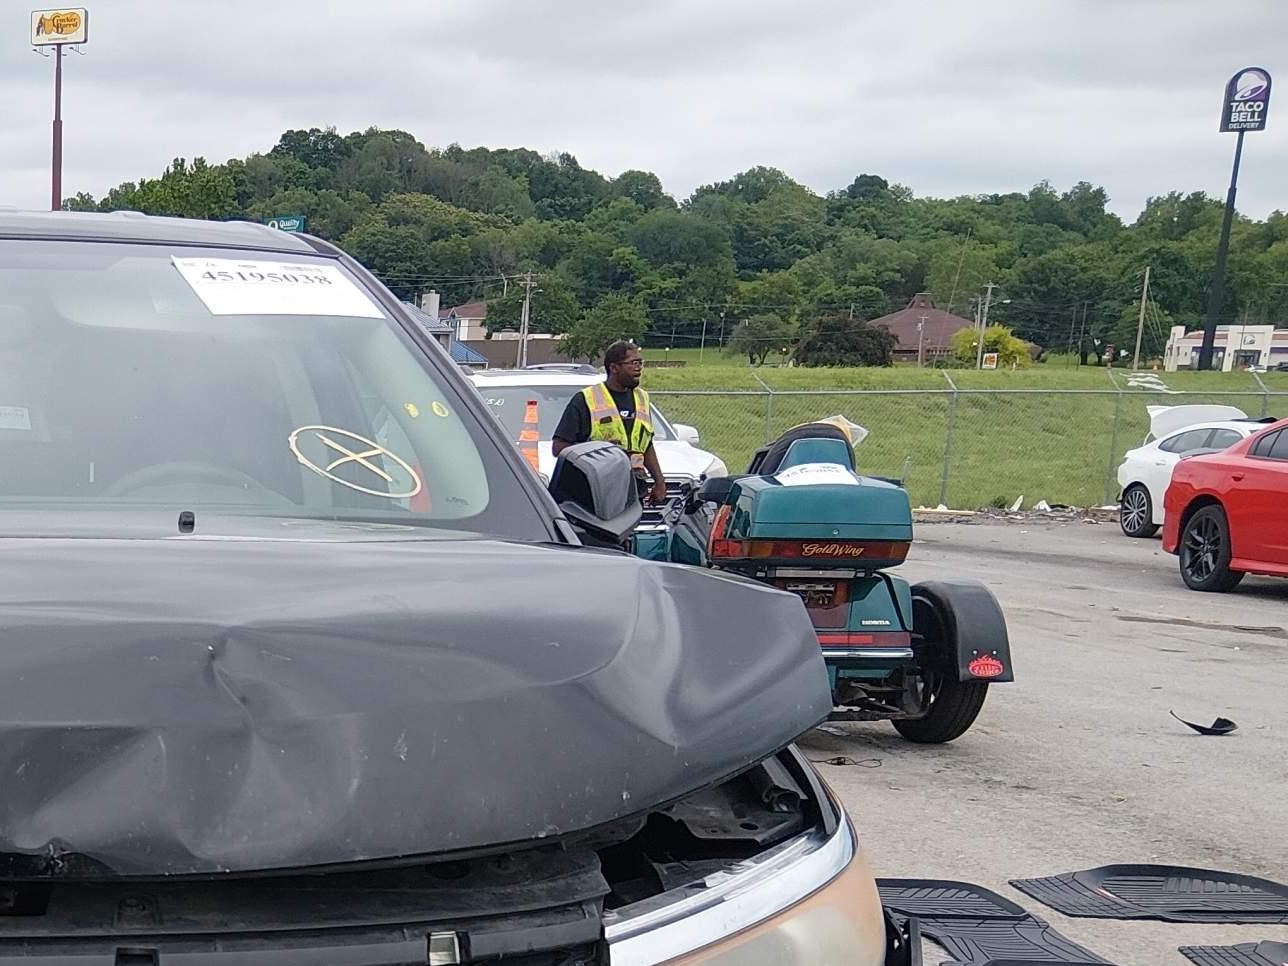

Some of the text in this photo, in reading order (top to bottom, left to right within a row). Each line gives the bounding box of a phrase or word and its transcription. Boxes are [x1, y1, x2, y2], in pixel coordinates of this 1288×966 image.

[1230, 101, 1264, 112] TACO
[1230, 112, 1261, 122] BELL
[201, 270, 333, 285] 45195038
